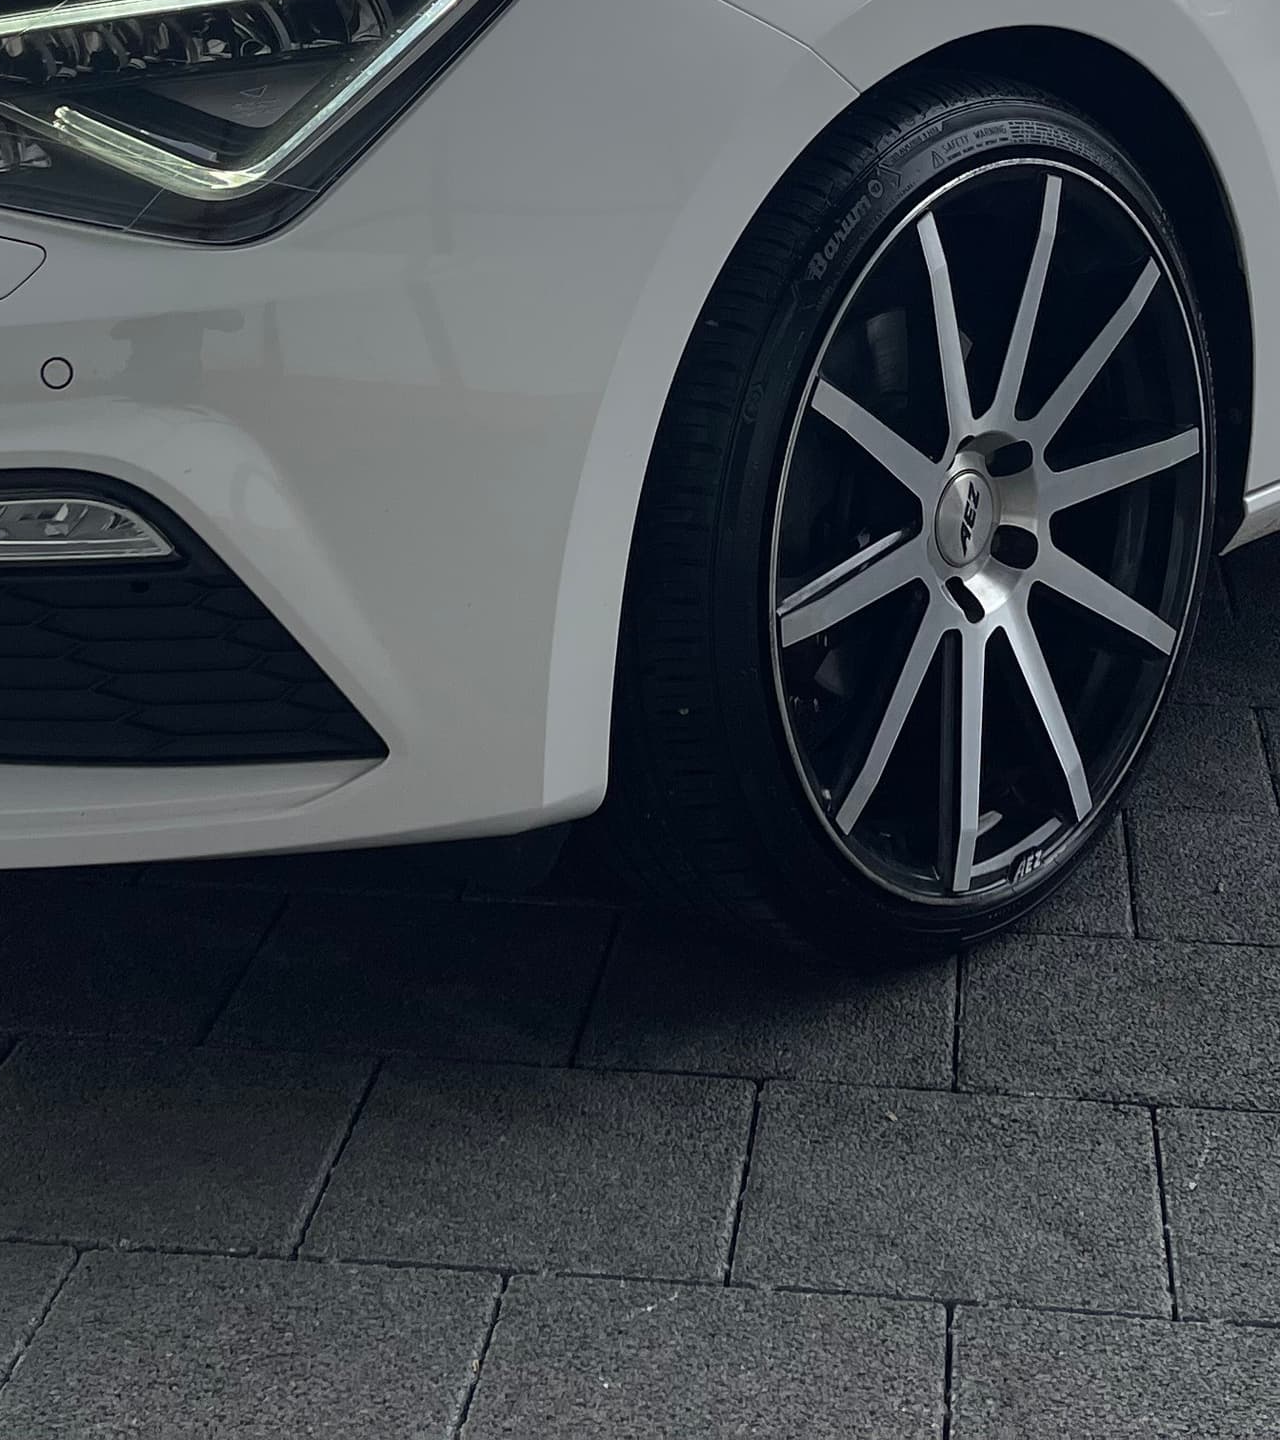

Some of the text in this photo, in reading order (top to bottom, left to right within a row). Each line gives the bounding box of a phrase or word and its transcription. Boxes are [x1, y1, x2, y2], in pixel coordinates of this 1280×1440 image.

[805, 195, 872, 280] Barum
[960, 481, 980, 557] AEZ
[1013, 849, 1043, 883] AEZ
